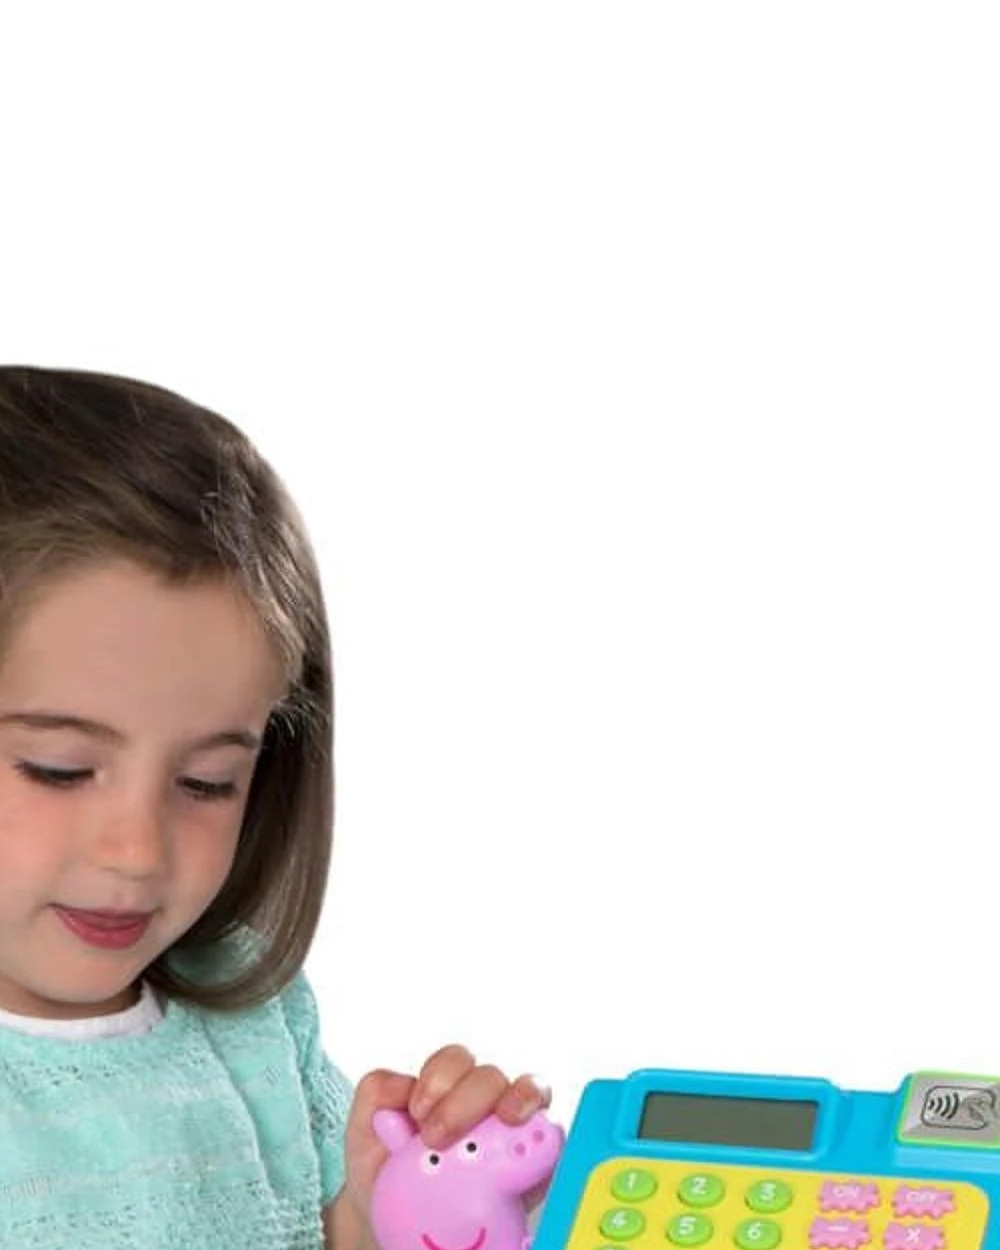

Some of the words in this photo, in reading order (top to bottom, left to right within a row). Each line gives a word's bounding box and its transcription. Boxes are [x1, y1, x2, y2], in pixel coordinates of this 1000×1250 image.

[692, 1176, 707, 1195] 2
[759, 1182, 776, 1200] 3
[612, 1210, 628, 1228] 4
[678, 1216, 697, 1235] 5
[746, 1221, 762, 1240] 6
